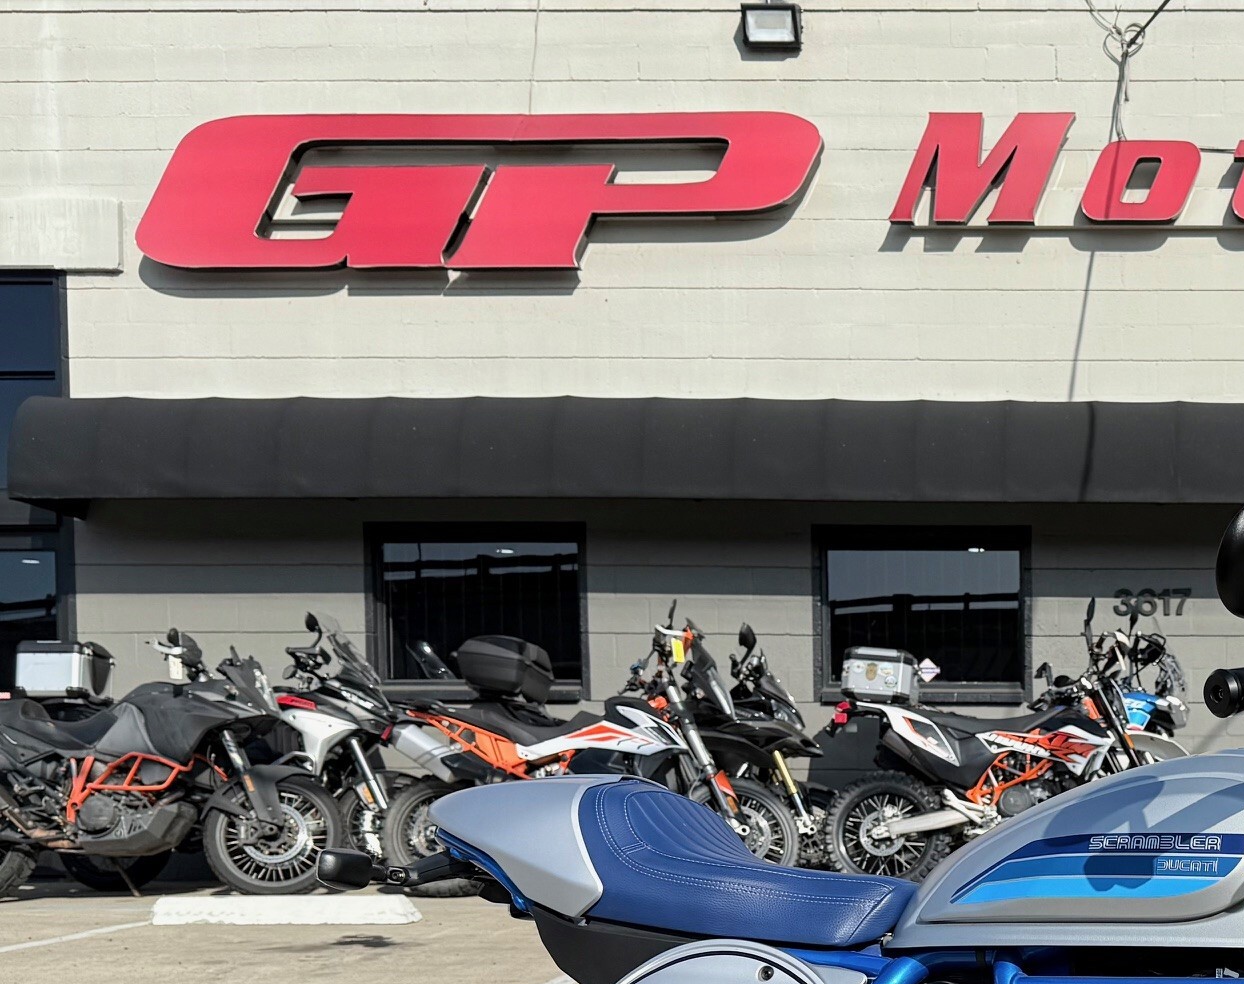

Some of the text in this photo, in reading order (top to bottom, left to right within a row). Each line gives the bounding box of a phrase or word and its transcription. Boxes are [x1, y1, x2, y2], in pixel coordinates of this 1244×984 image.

[135, 110, 825, 270] GP
[1113, 588, 1192, 617] 3617
[1088, 835, 1222, 851] SCRAMBLER
[1156, 857, 1219, 874] DUCATI
